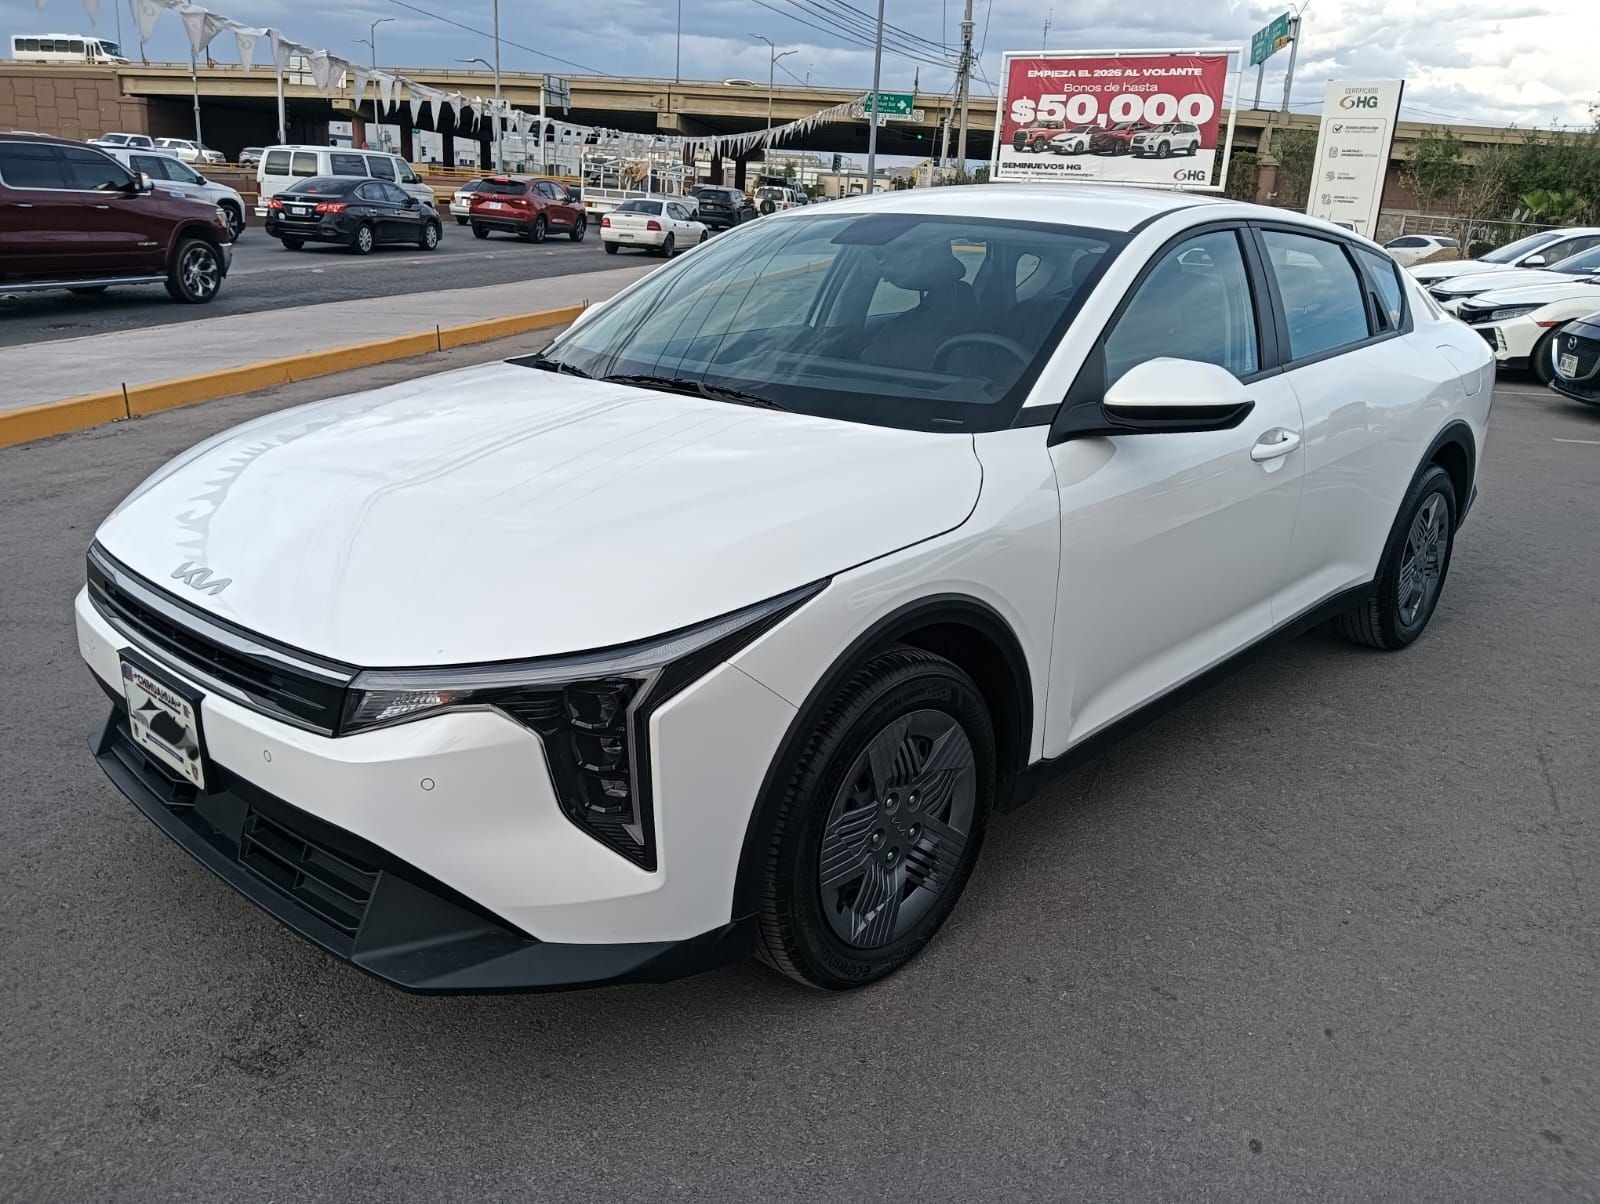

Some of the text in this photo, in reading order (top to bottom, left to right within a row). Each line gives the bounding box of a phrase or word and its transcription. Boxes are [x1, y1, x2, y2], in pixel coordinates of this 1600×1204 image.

[1027, 67, 1203, 78] EMPIEZA EL 2026 AL VOLANTE
[1063, 82, 1158, 92] Bonos de hasta
[1356, 95, 1378, 108] HG
[1010, 93, 1215, 128] $50,000
[1002, 162, 1064, 170] SEMINUEVOS
[1187, 169, 1206, 182] HG
[170, 561, 233, 596] KIA
